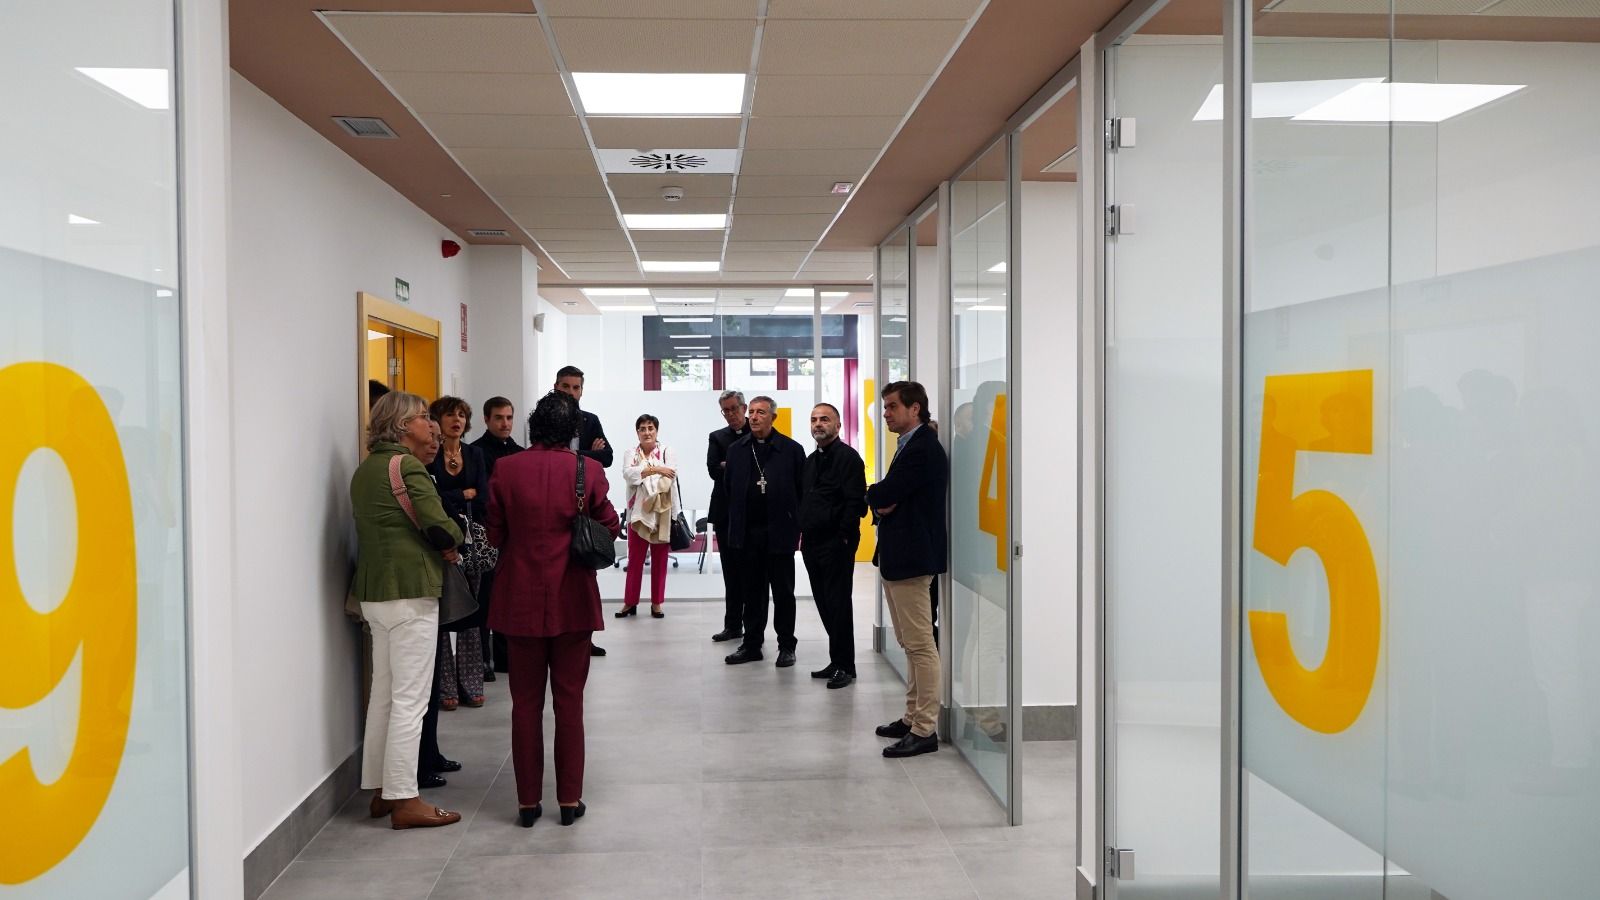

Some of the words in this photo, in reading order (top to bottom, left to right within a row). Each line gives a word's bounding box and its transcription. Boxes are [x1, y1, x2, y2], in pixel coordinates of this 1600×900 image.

[0, 361, 137, 885] 9
[979, 394, 1007, 572] 4
[1248, 369, 1380, 734] 5
